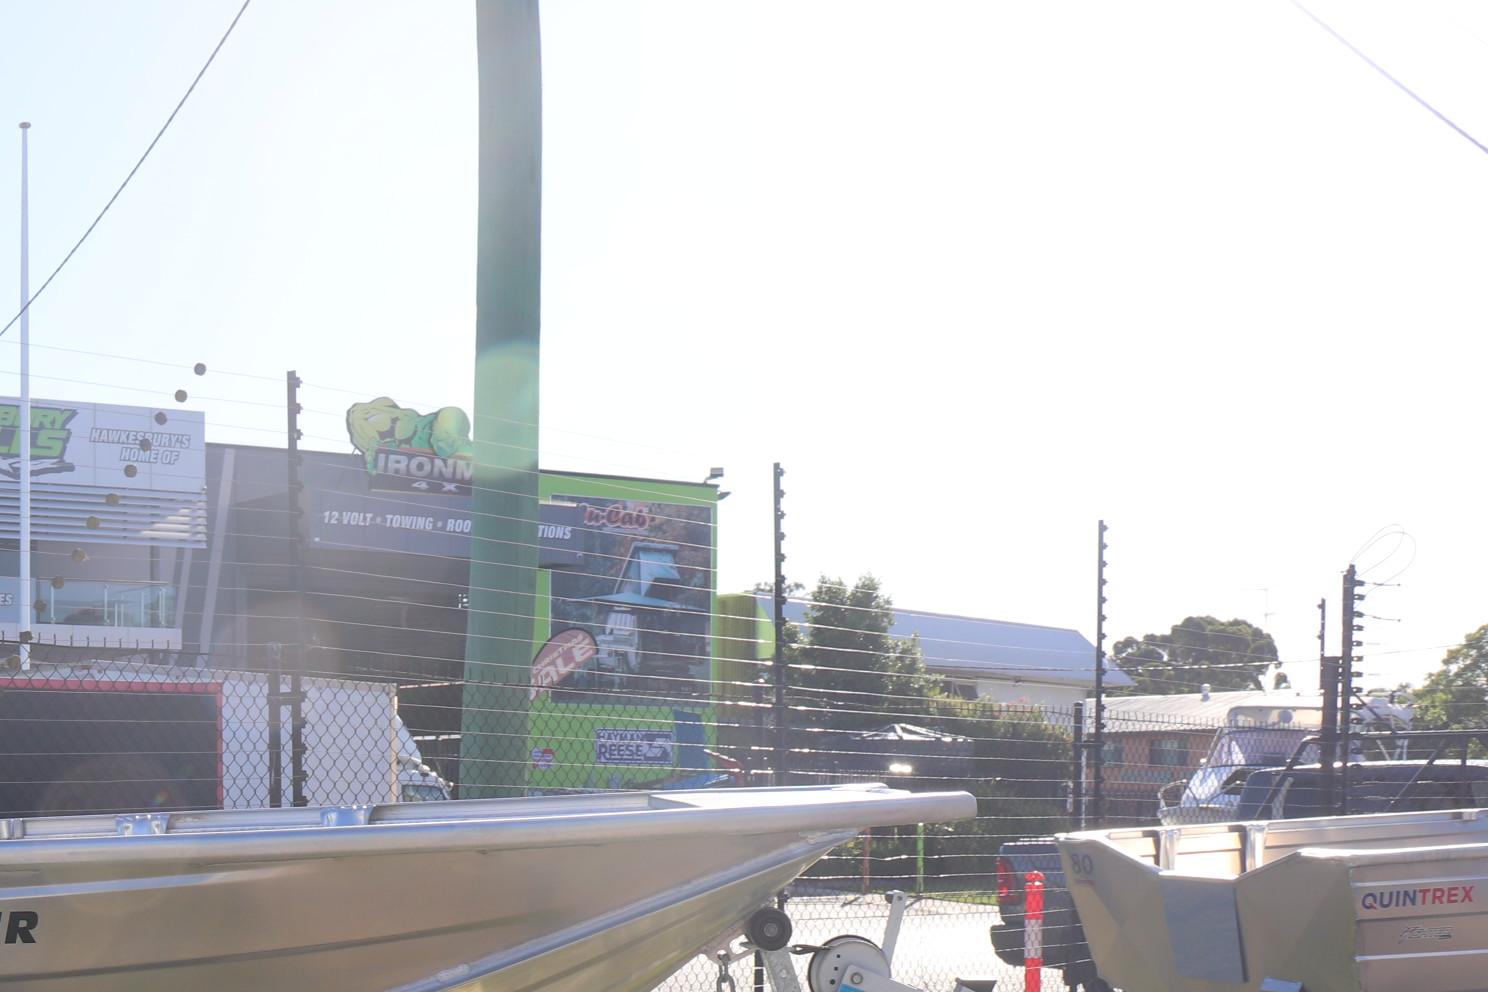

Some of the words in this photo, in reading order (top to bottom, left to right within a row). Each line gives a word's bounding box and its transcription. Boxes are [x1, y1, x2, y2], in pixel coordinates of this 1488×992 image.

[119, 447, 159, 464] HOME
[161, 450, 180, 465] OF
[376, 453, 473, 481] IRONM
[323, 510, 338, 525] 12
[342, 511, 373, 526] VOLT
[385, 514, 434, 531] TOWING
[446, 517, 472, 534] ROO
[597, 743, 645, 762] REESE
[1361, 885, 1475, 910] QUINTREX
